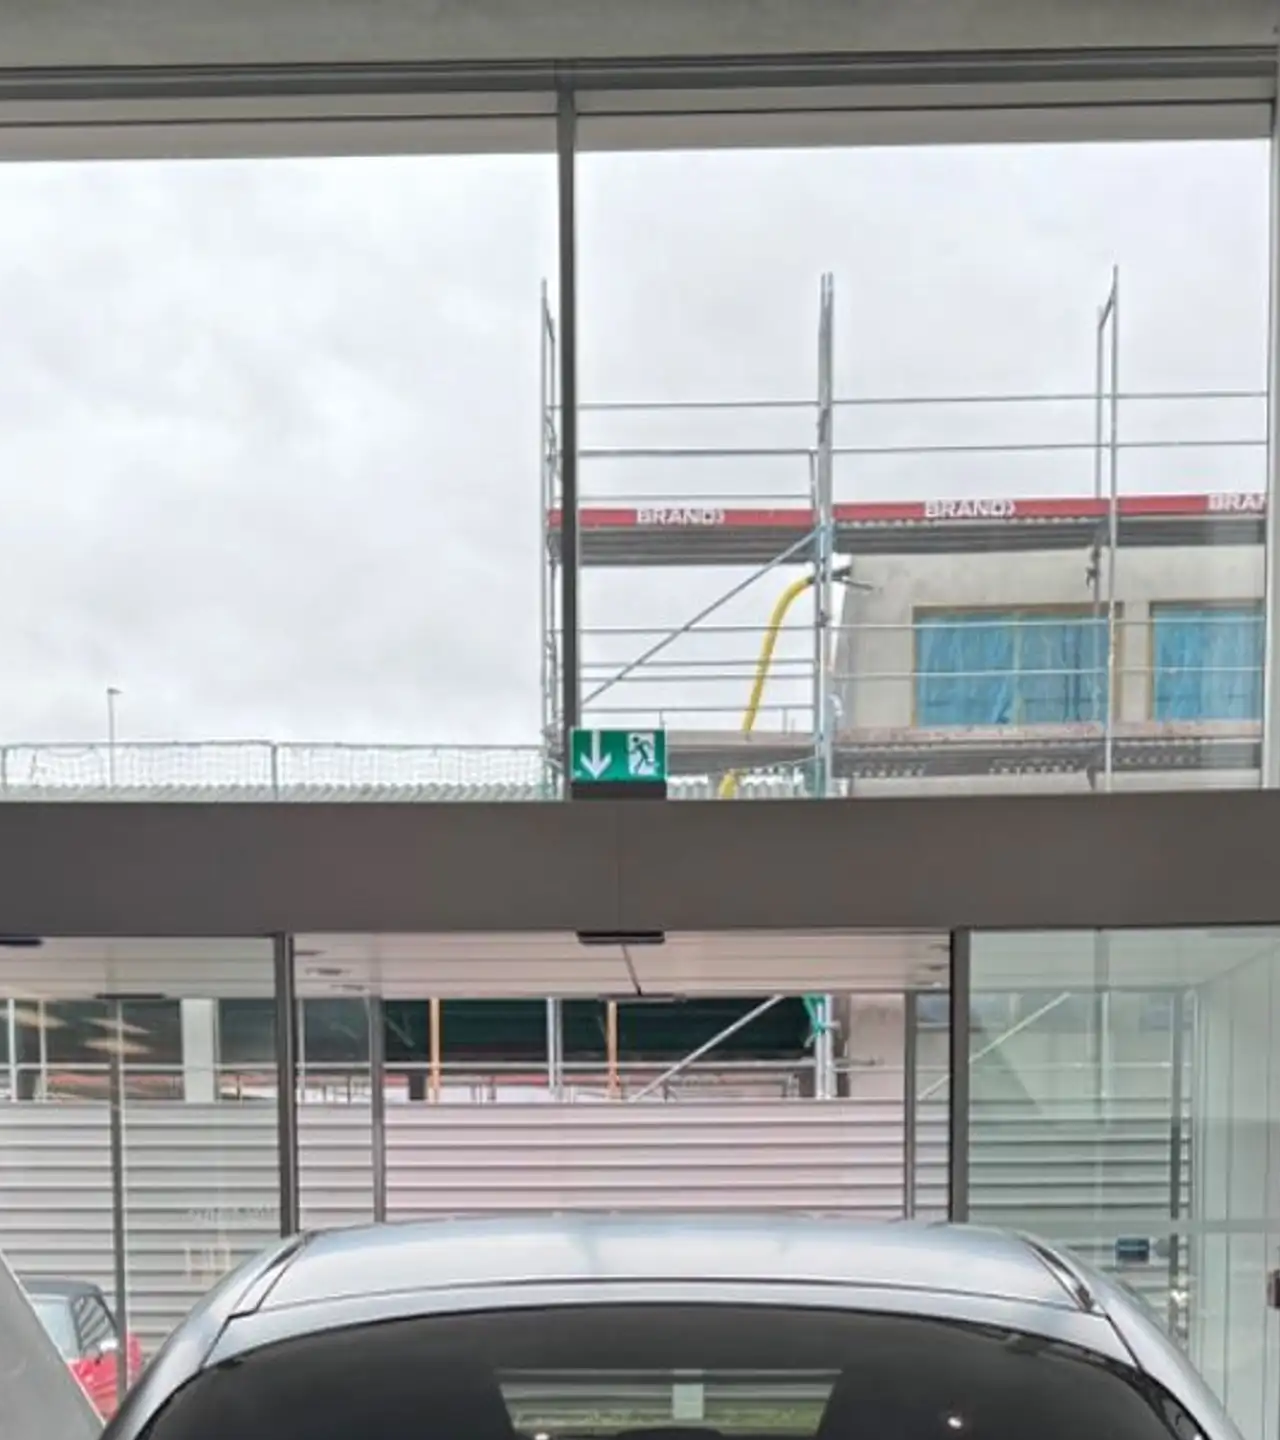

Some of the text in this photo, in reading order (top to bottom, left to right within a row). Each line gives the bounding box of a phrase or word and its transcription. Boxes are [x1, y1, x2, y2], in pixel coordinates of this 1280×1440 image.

[924, 500, 1011, 517] BRAND
[1208, 493, 1266, 511] BRAN
[637, 508, 721, 525] BRAND
